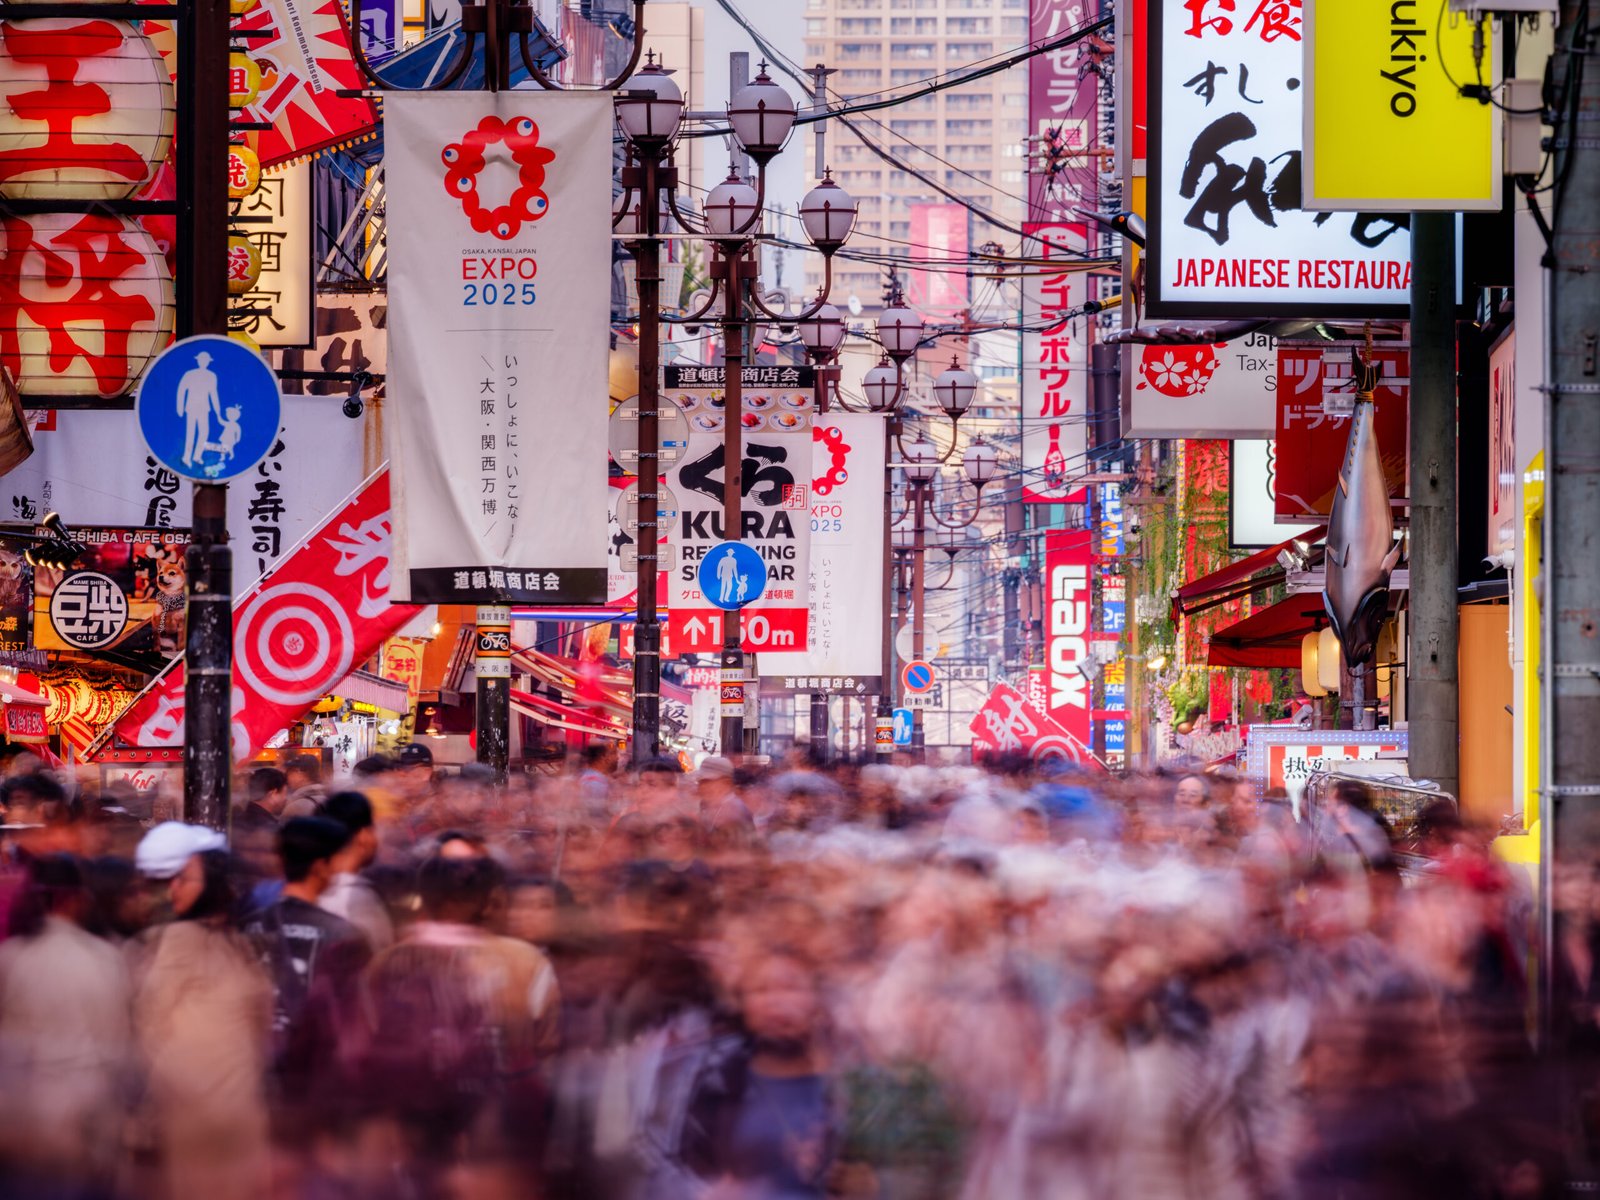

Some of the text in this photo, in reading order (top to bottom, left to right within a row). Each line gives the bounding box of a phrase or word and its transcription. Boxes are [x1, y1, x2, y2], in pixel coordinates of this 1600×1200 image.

[462, 257, 537, 280] EXPO
[1172, 258, 1290, 288] JAPANESE
[463, 283, 537, 306] 2025
[811, 505, 843, 518] XPO
[681, 510, 796, 540] KURA
[811, 519, 842, 532] 025
[37, 530, 118, 543] MAESHIBA
[123, 532, 161, 544] CAFE
[682, 545, 796, 560] REING
[453, 571, 560, 591] 道頓堀商店会
[768, 564, 795, 581] AR
